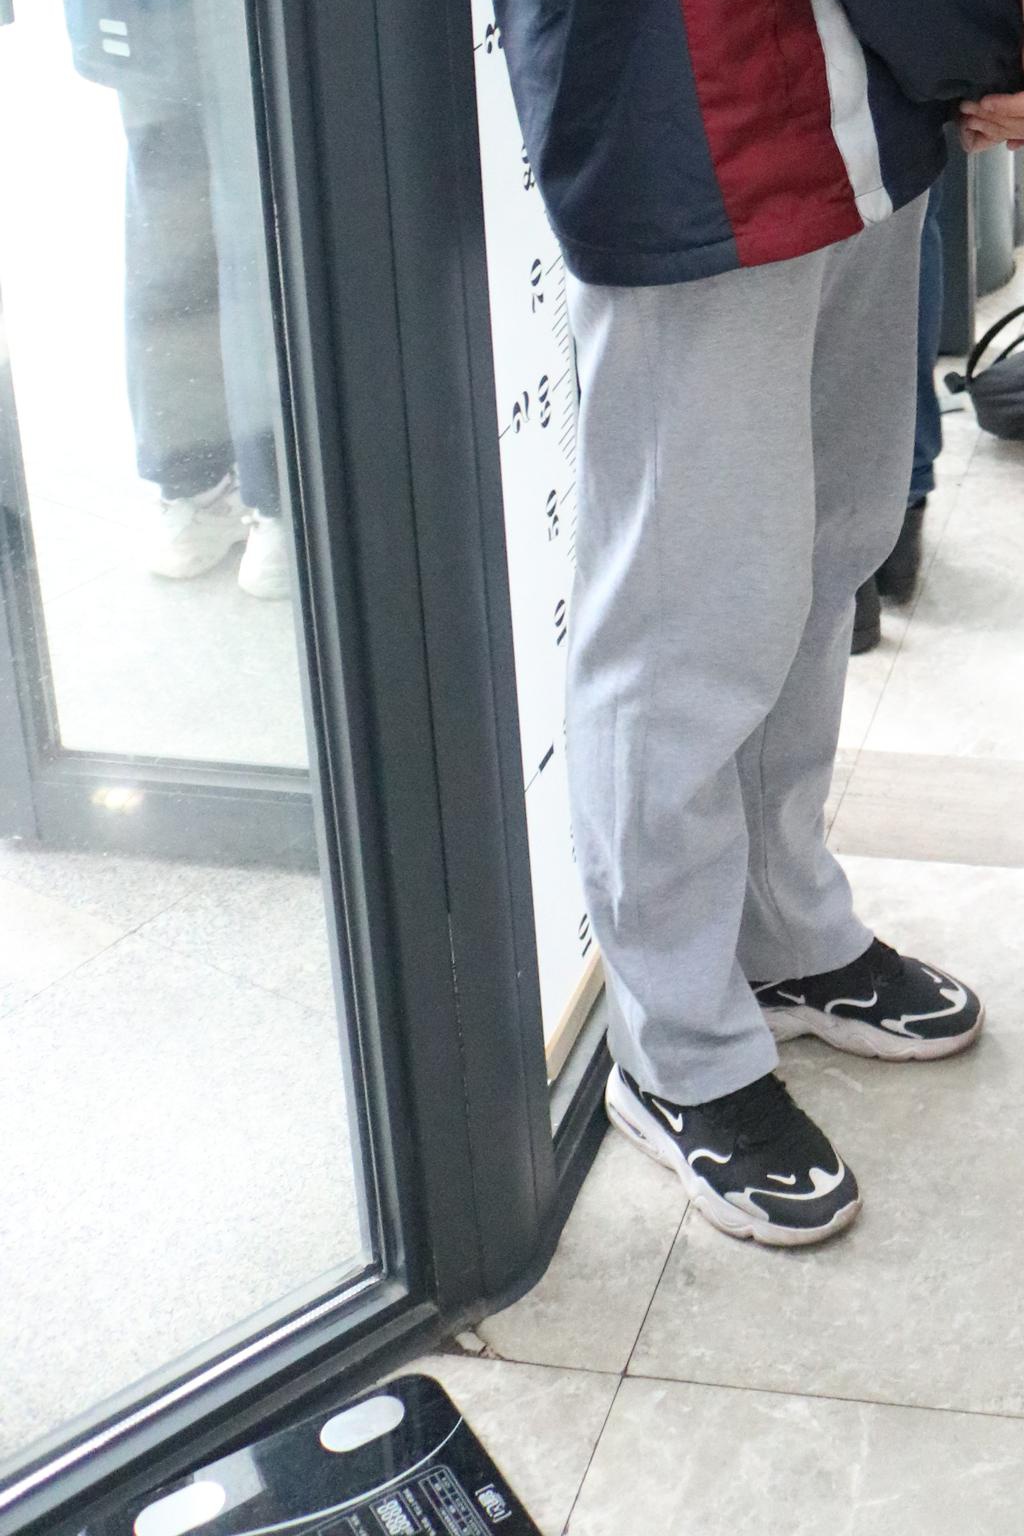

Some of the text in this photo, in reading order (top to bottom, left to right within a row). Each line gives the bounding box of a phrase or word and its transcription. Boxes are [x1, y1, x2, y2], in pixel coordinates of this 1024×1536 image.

[530, 258, 544, 314] 70
[538, 374, 551, 429] 60
[546, 488, 559, 543] 50
